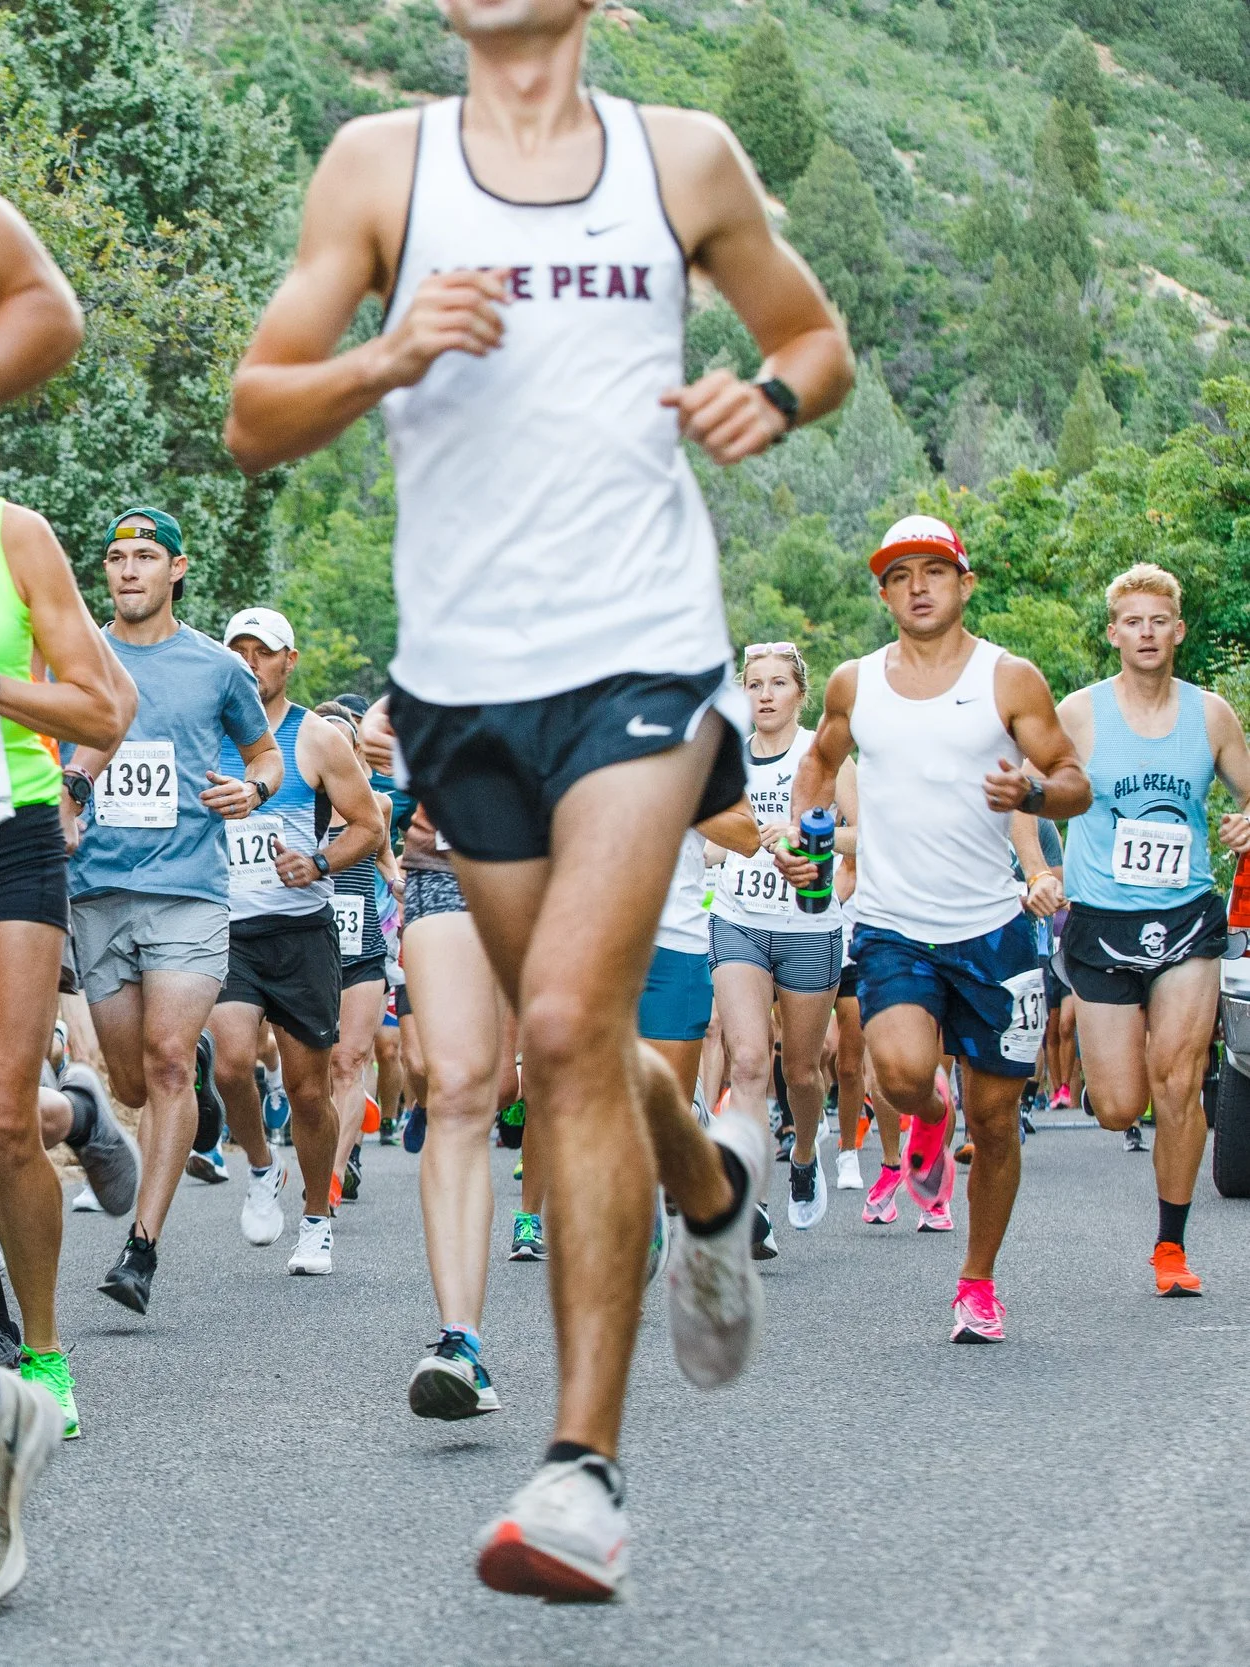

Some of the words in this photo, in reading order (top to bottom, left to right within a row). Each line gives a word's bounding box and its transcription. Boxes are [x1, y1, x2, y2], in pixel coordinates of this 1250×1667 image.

[549, 264, 653, 301] PEAK
[103, 762, 171, 798] 1392
[1114, 775, 1141, 800] GILL
[1143, 773, 1191, 801] GREATS
[1121, 840, 1185, 875] 1377
[734, 869, 789, 903] 1391
